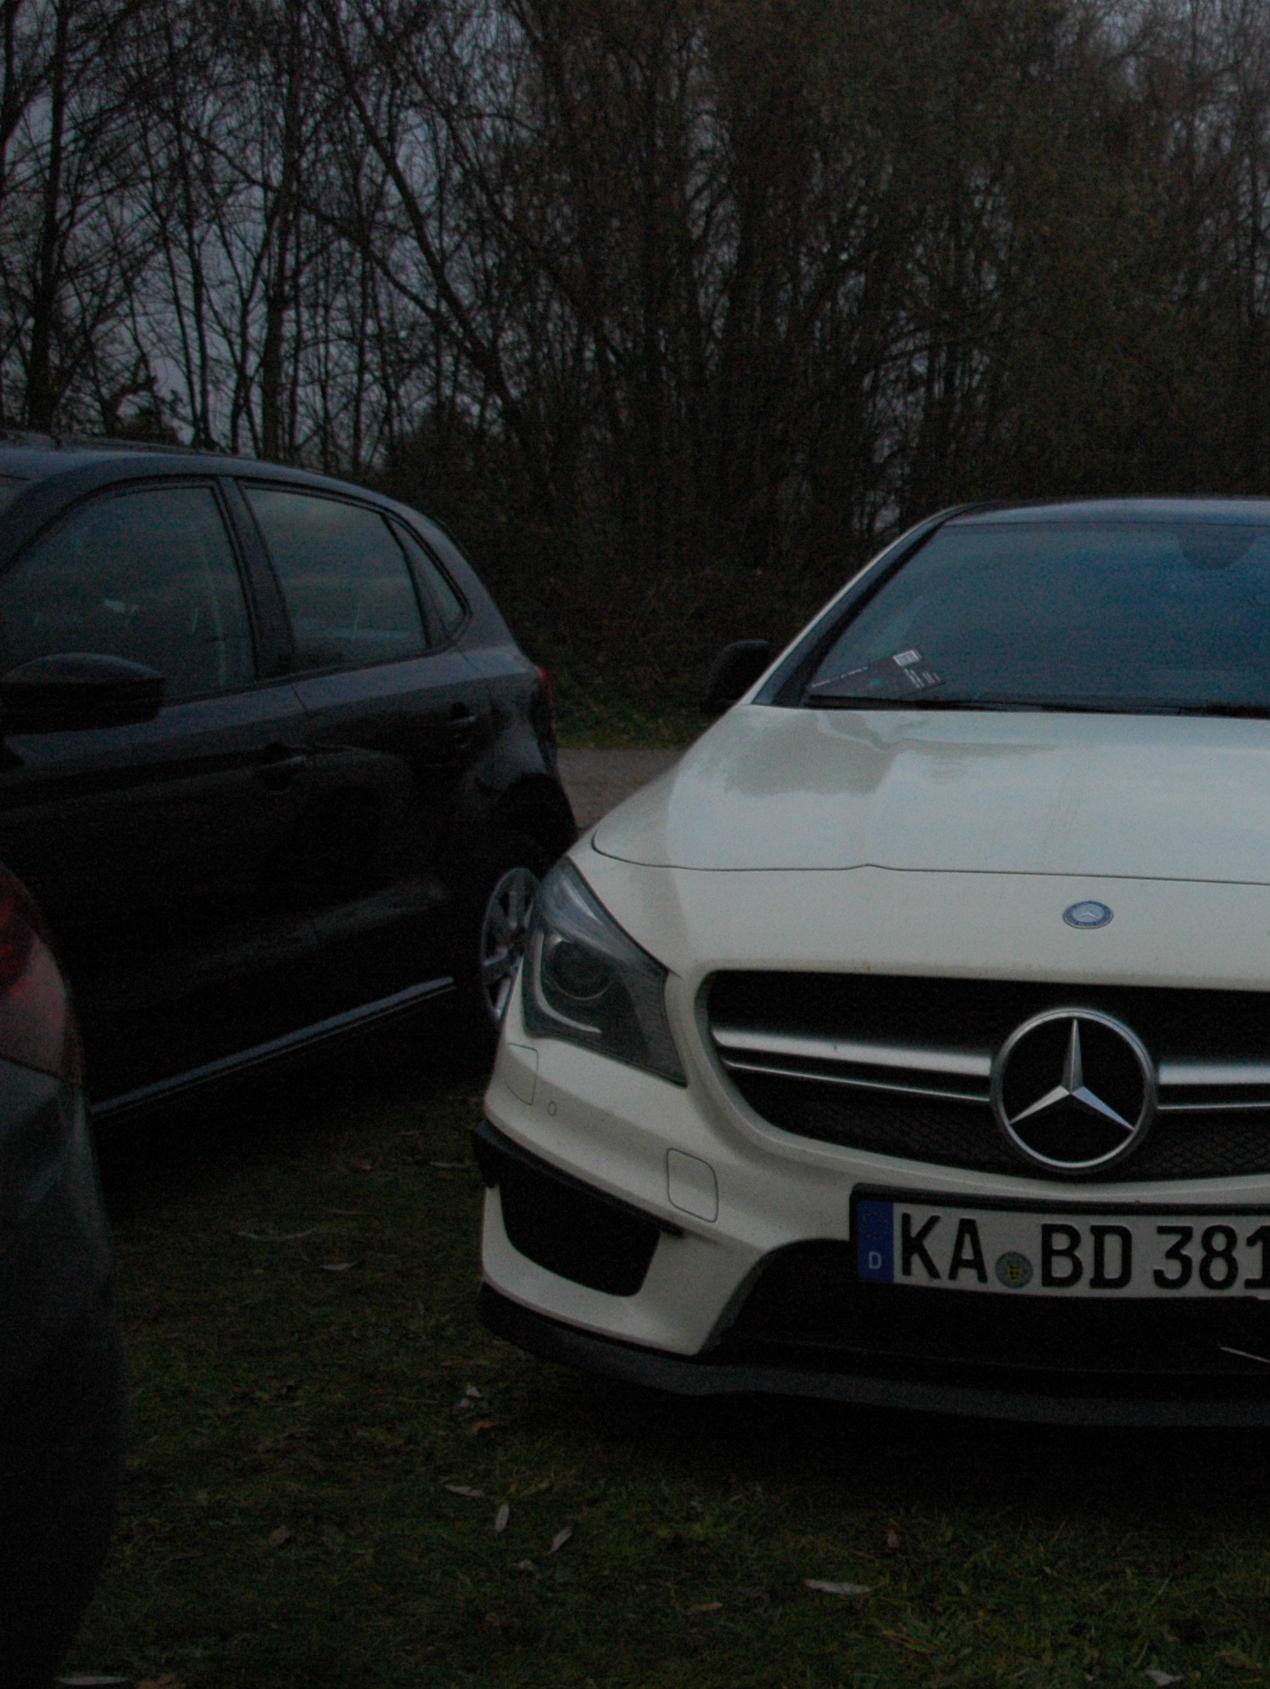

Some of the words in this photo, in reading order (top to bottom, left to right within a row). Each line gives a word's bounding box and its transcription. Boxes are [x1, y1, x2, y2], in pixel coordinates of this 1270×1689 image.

[868, 1251, 883, 1270] D
[901, 1212, 988, 1283] KA
[1041, 1223, 1133, 1289] BD
